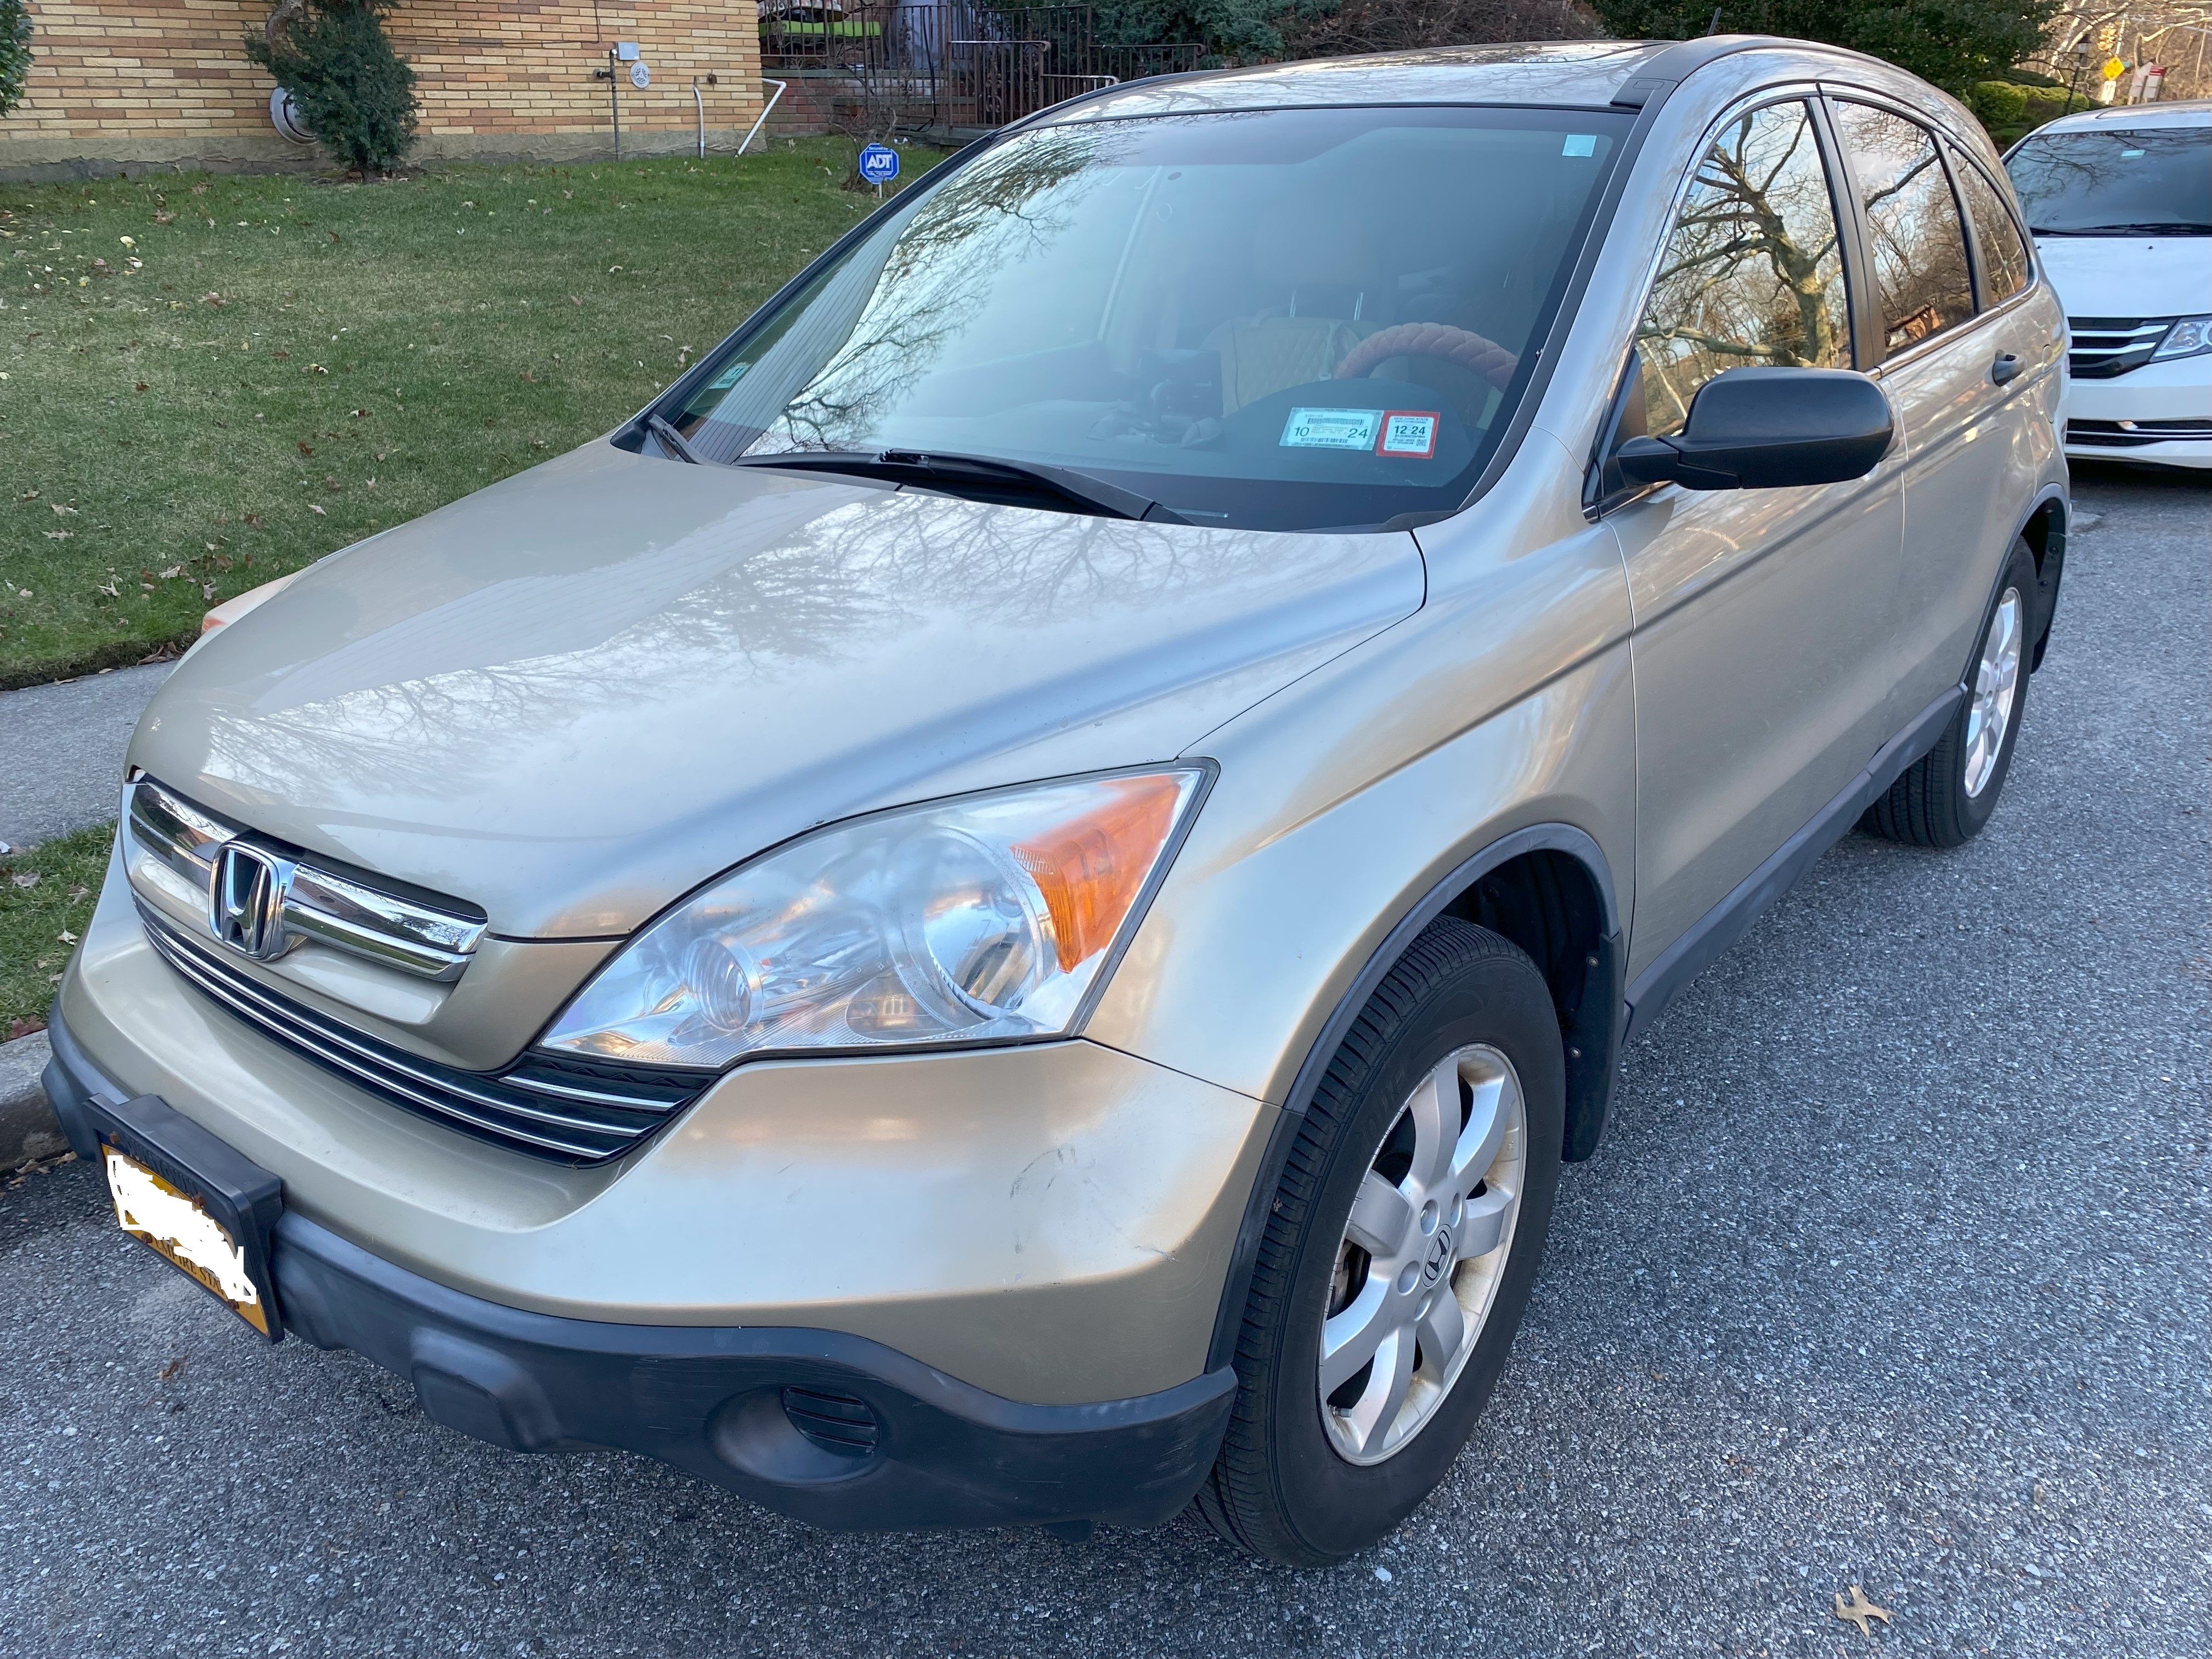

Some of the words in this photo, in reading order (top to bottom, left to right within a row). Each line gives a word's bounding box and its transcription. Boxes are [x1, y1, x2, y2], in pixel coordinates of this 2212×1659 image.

[866, 154, 893, 168] ADT
[1295, 427, 1310, 437] 10
[1347, 428, 1368, 439] 24
[1394, 425, 1408, 434] 12
[1411, 426, 1425, 435] 24
